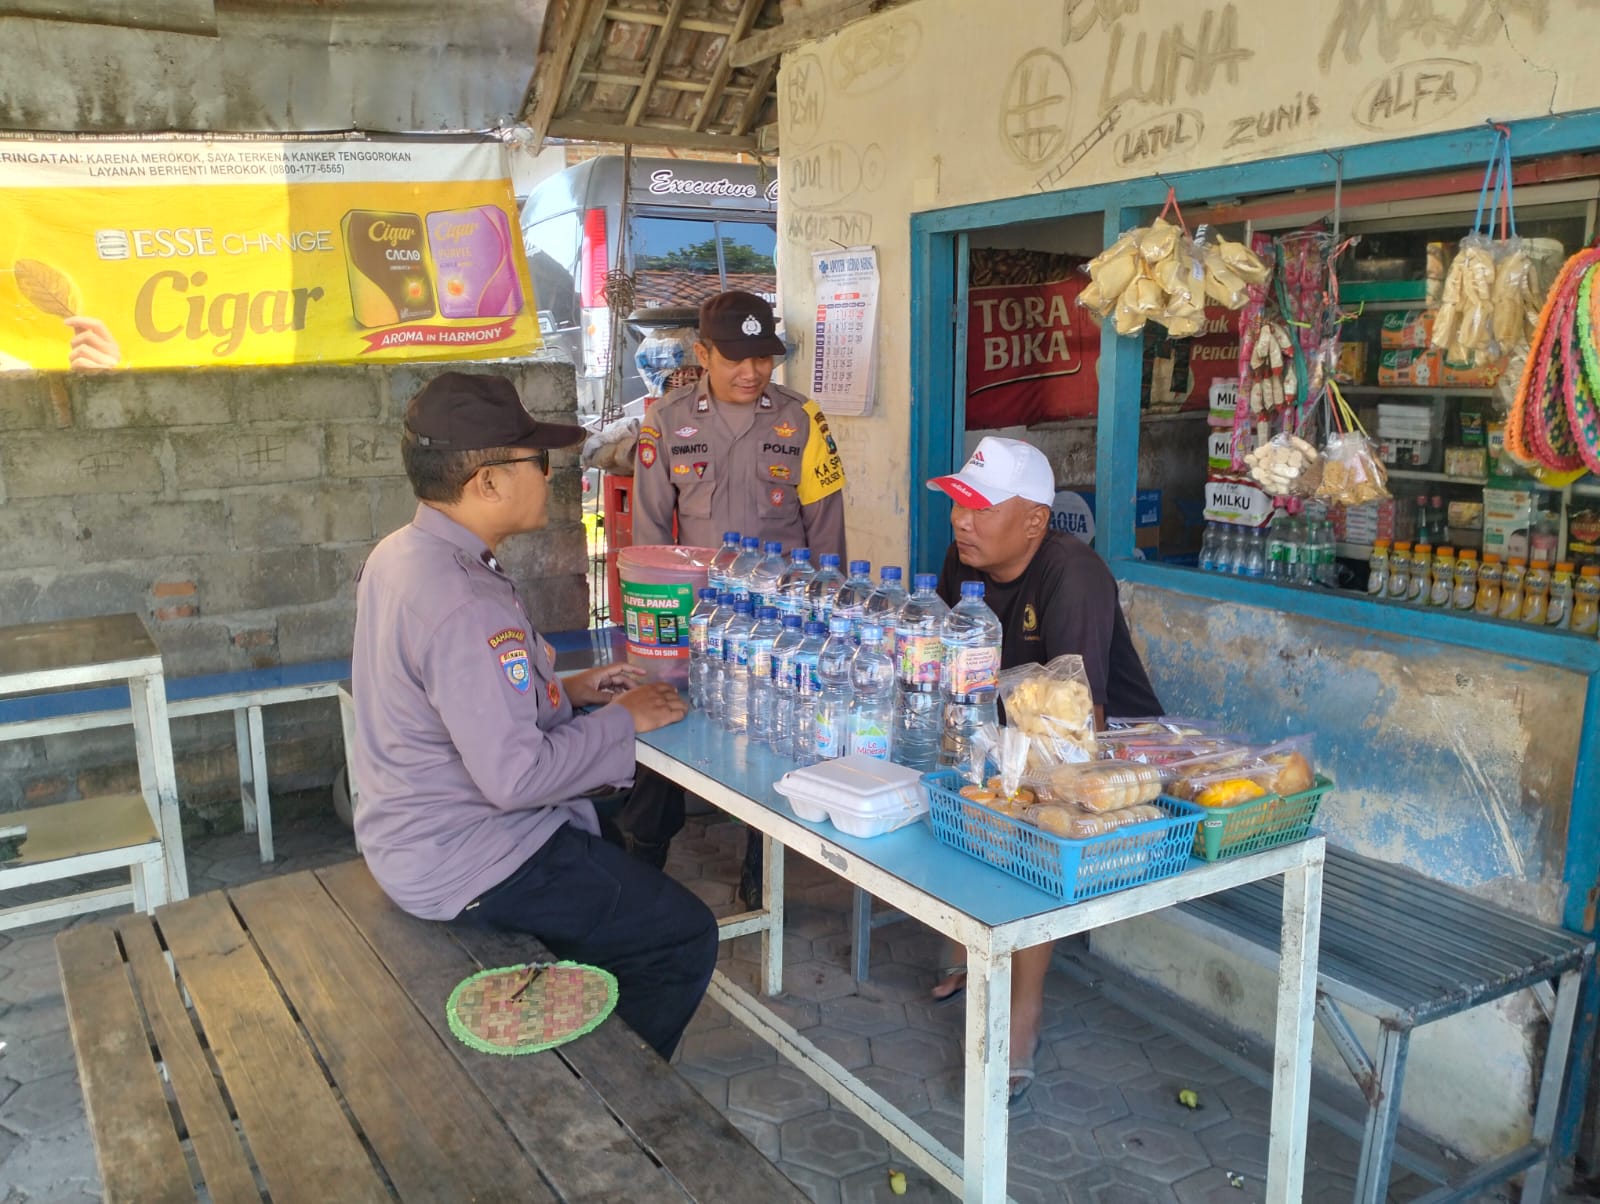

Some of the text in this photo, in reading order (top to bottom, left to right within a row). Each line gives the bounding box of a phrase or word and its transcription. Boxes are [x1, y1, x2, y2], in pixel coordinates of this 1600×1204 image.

[1368, 71, 1457, 122] ALFA
[0, 151, 412, 165] RINGATAN: KARENA MEROKOK, SAYA TERKENA KANKER TENGGOROKAN
[88, 163, 345, 177] LAYANAN BERHENTI MEROKOK (0800-177-6565)
[649, 169, 757, 197] Executive
[131, 227, 336, 259] ESSE CHANGE
[368, 220, 416, 247] Cigar
[434, 221, 480, 244] Cigar
[385, 249, 421, 261] CACAO
[134, 270, 325, 357] Cigar
[973, 295, 1070, 333] TORA
[381, 327, 503, 346] AROMA IN HARMONY
[984, 331, 1071, 371] BIKA
[671, 443, 708, 456] ISWANTO
[763, 443, 800, 456] POLRI
[1212, 493, 1251, 510] MILKU
[646, 599, 680, 609] PANAS
